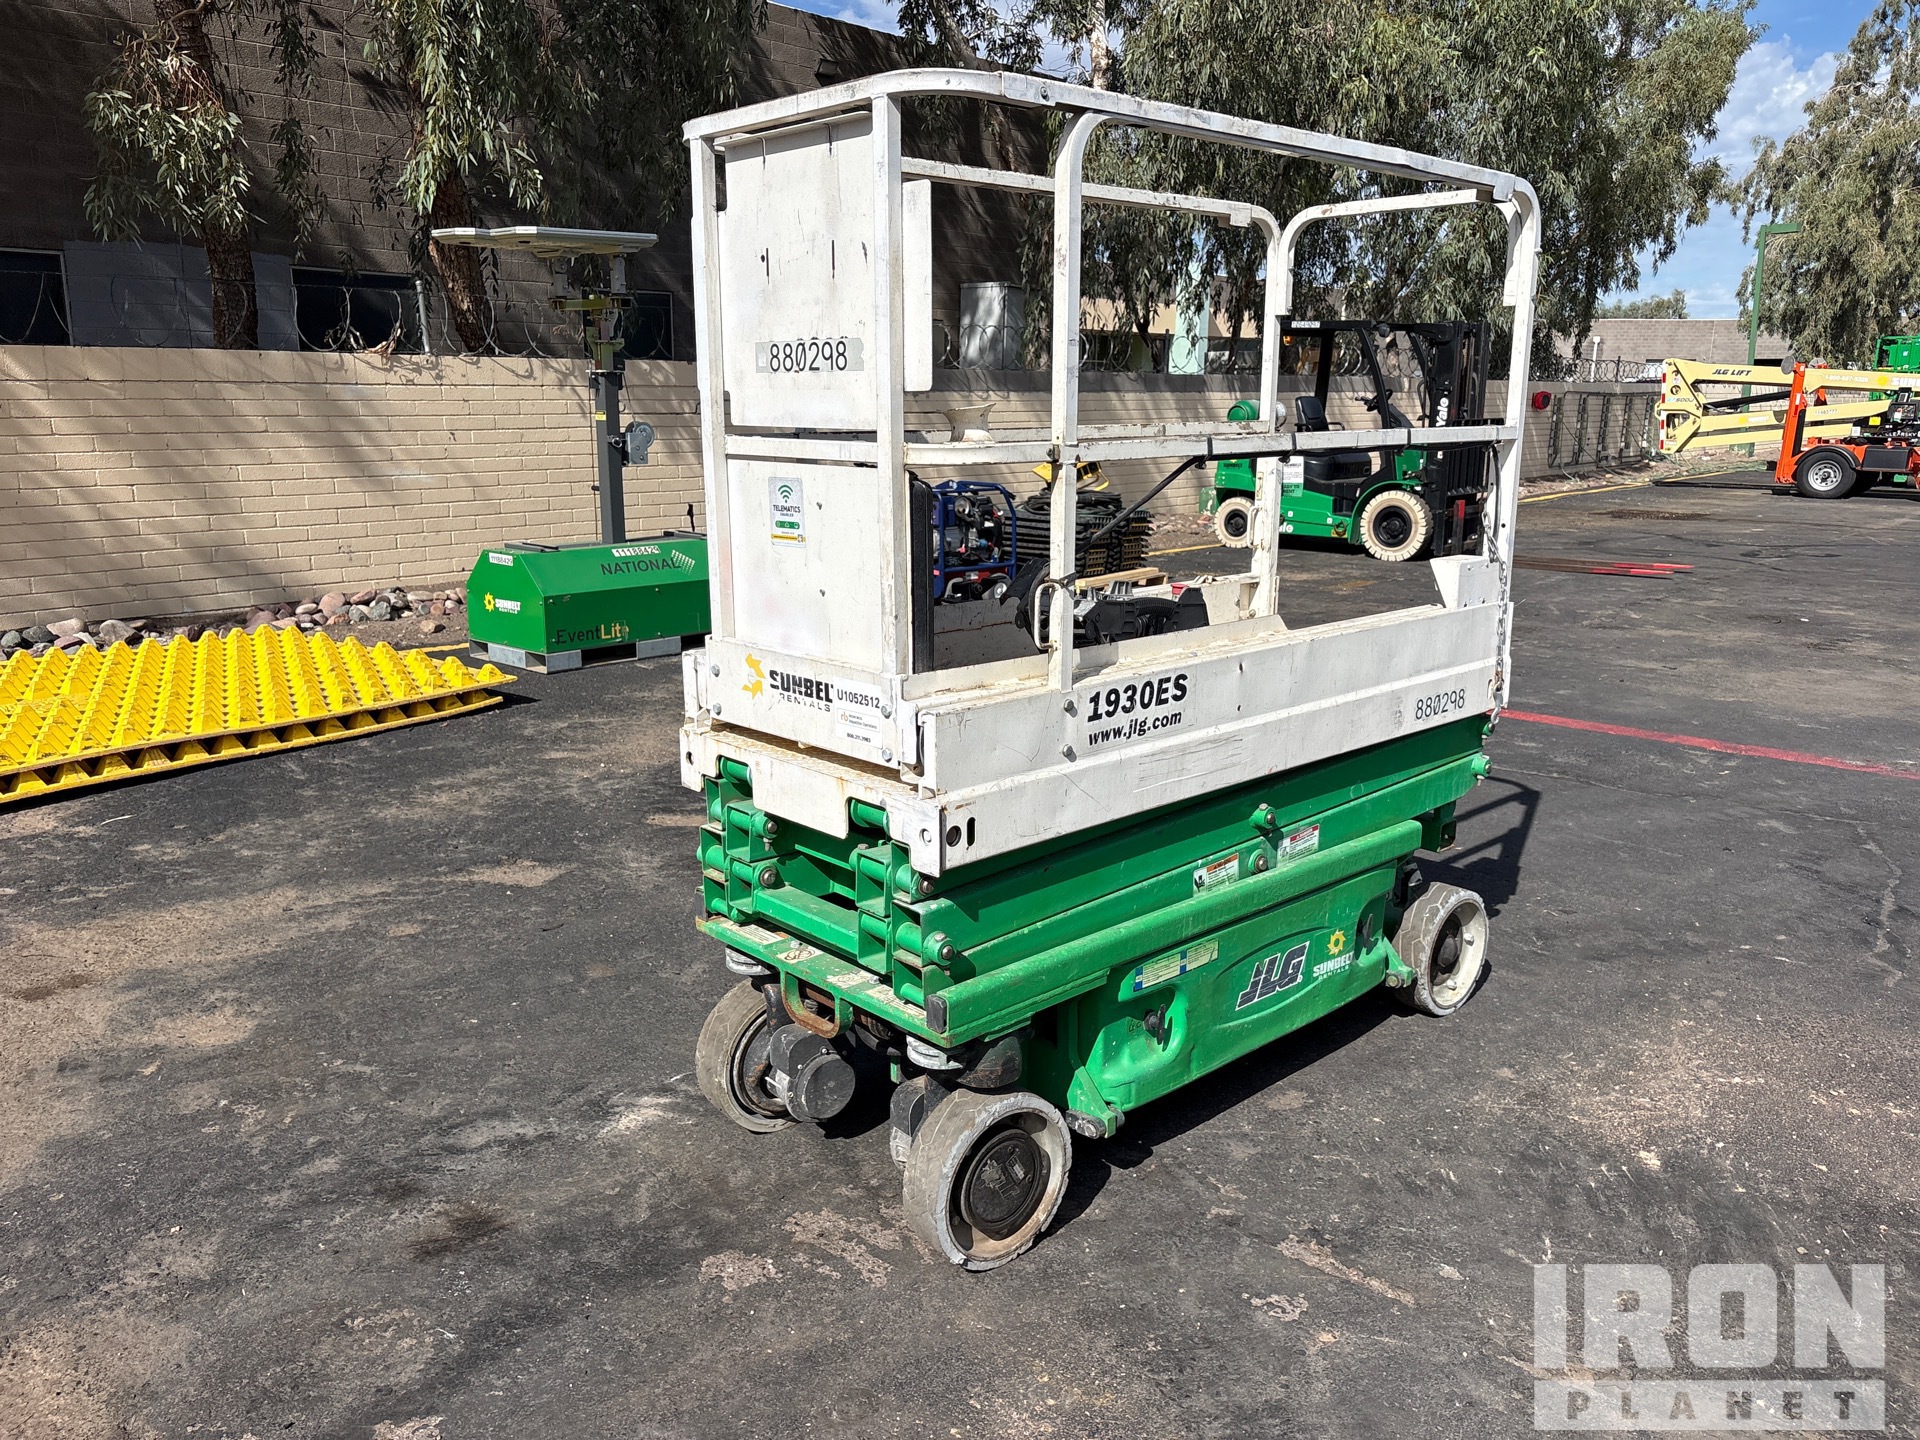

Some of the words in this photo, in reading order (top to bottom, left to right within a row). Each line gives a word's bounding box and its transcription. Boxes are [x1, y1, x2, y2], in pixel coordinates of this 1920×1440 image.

[770, 341, 848, 372] 880298
[1712, 368, 1730, 376] JLG
[1436, 397, 1449, 427] Yale
[772, 504, 801, 514] TELEMATICS
[615, 546, 660, 557] 11188429
[600, 557, 682, 576] NATIONAL
[836, 688, 881, 709] U1052512
[1087, 673, 1189, 723] 1930ES
[1415, 688, 1466, 720] 880298
[1088, 711, 1183, 746] www.jlg.com
[1235, 941, 1310, 1011] JLG
[1312, 951, 1355, 978] SUNBELT
